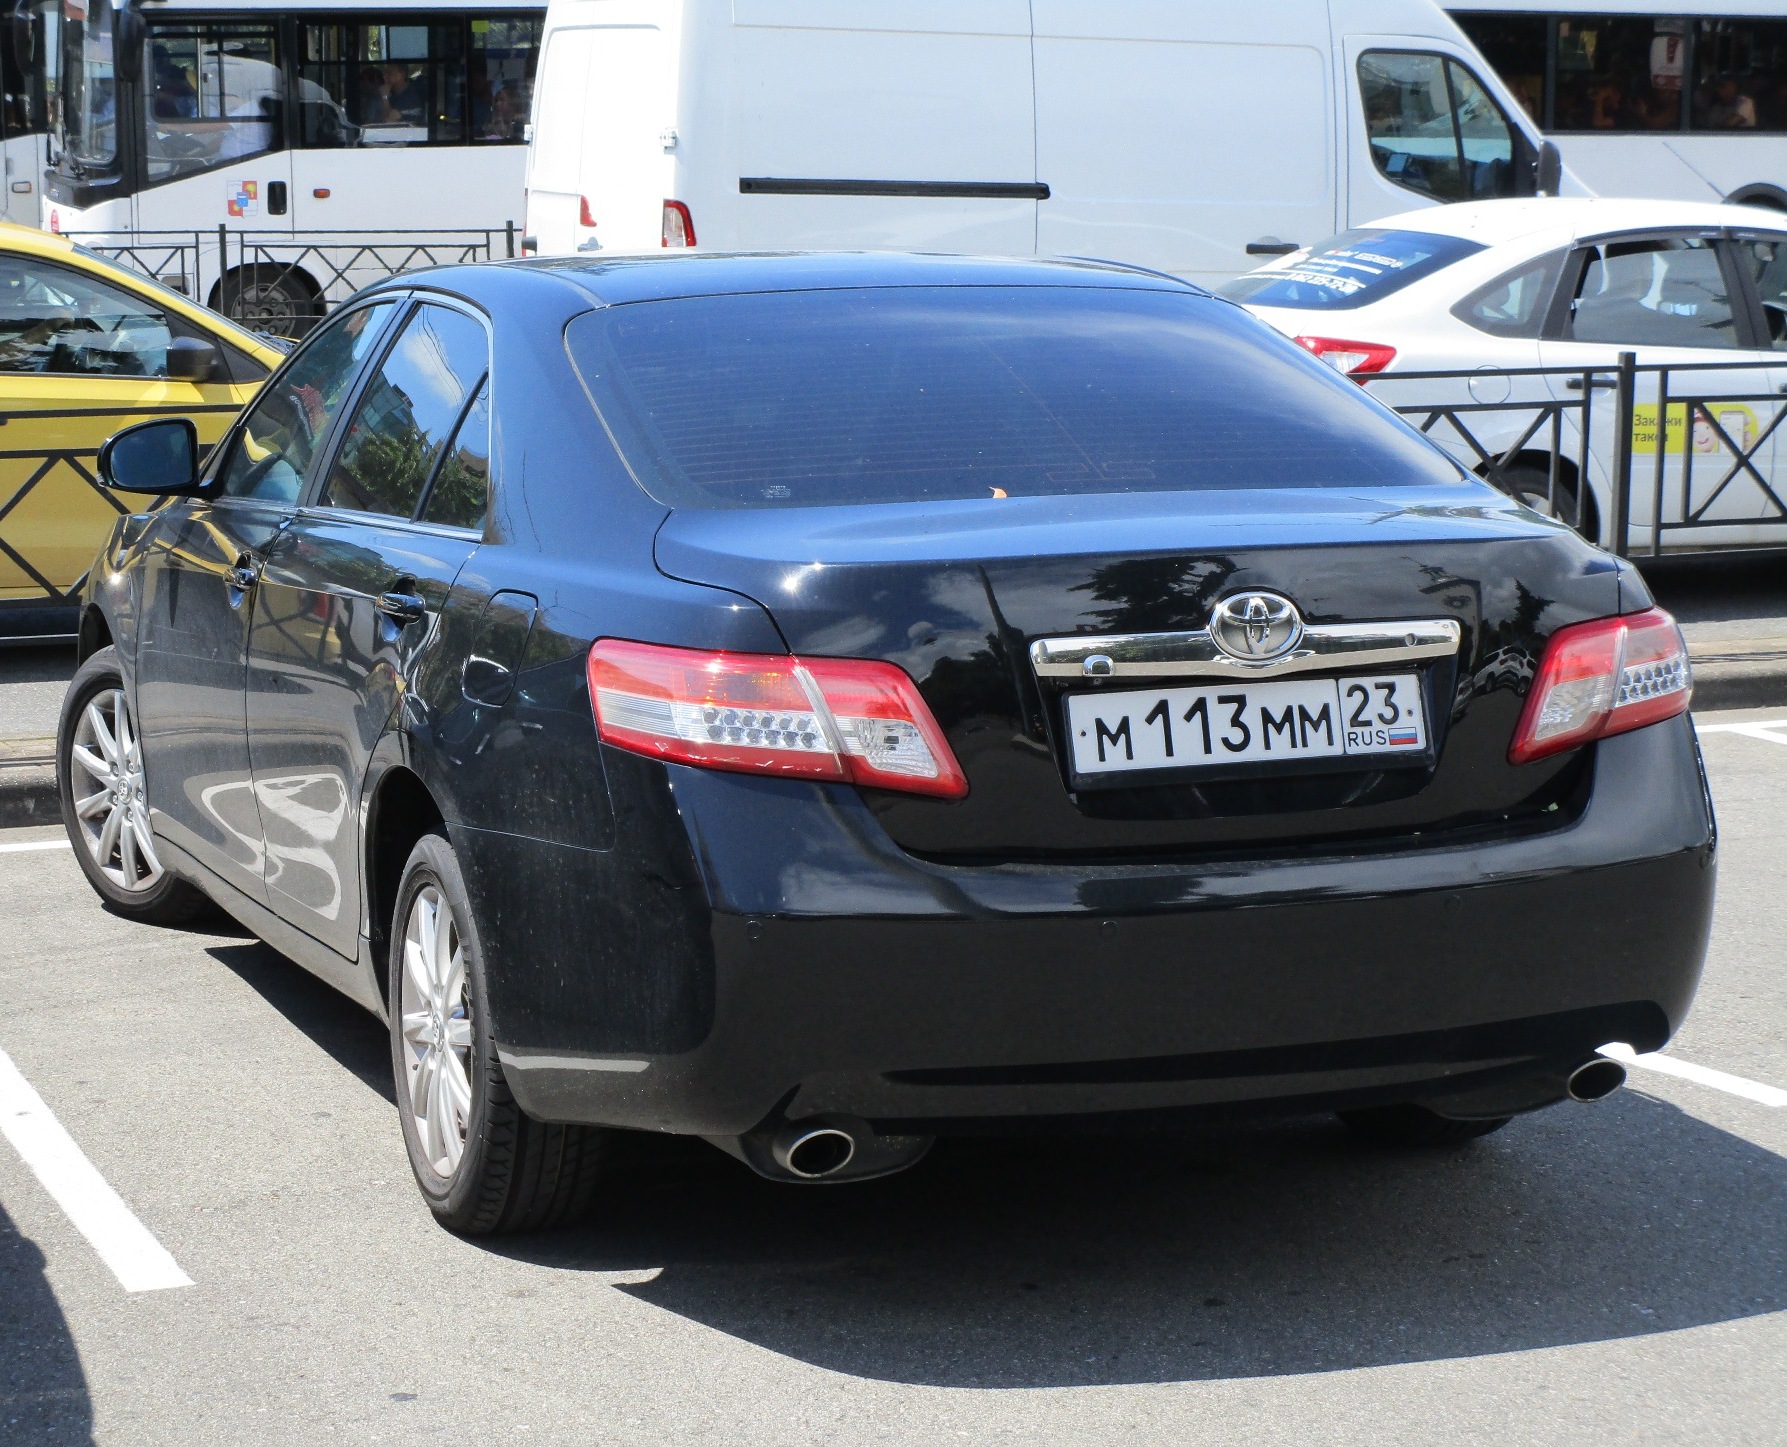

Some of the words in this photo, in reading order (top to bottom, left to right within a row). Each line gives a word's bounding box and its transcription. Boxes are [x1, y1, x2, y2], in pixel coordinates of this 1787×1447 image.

[1633, 413, 1682, 427] Закжи
[1346, 680, 1400, 728] 23
[1347, 730, 1387, 747] RUS
